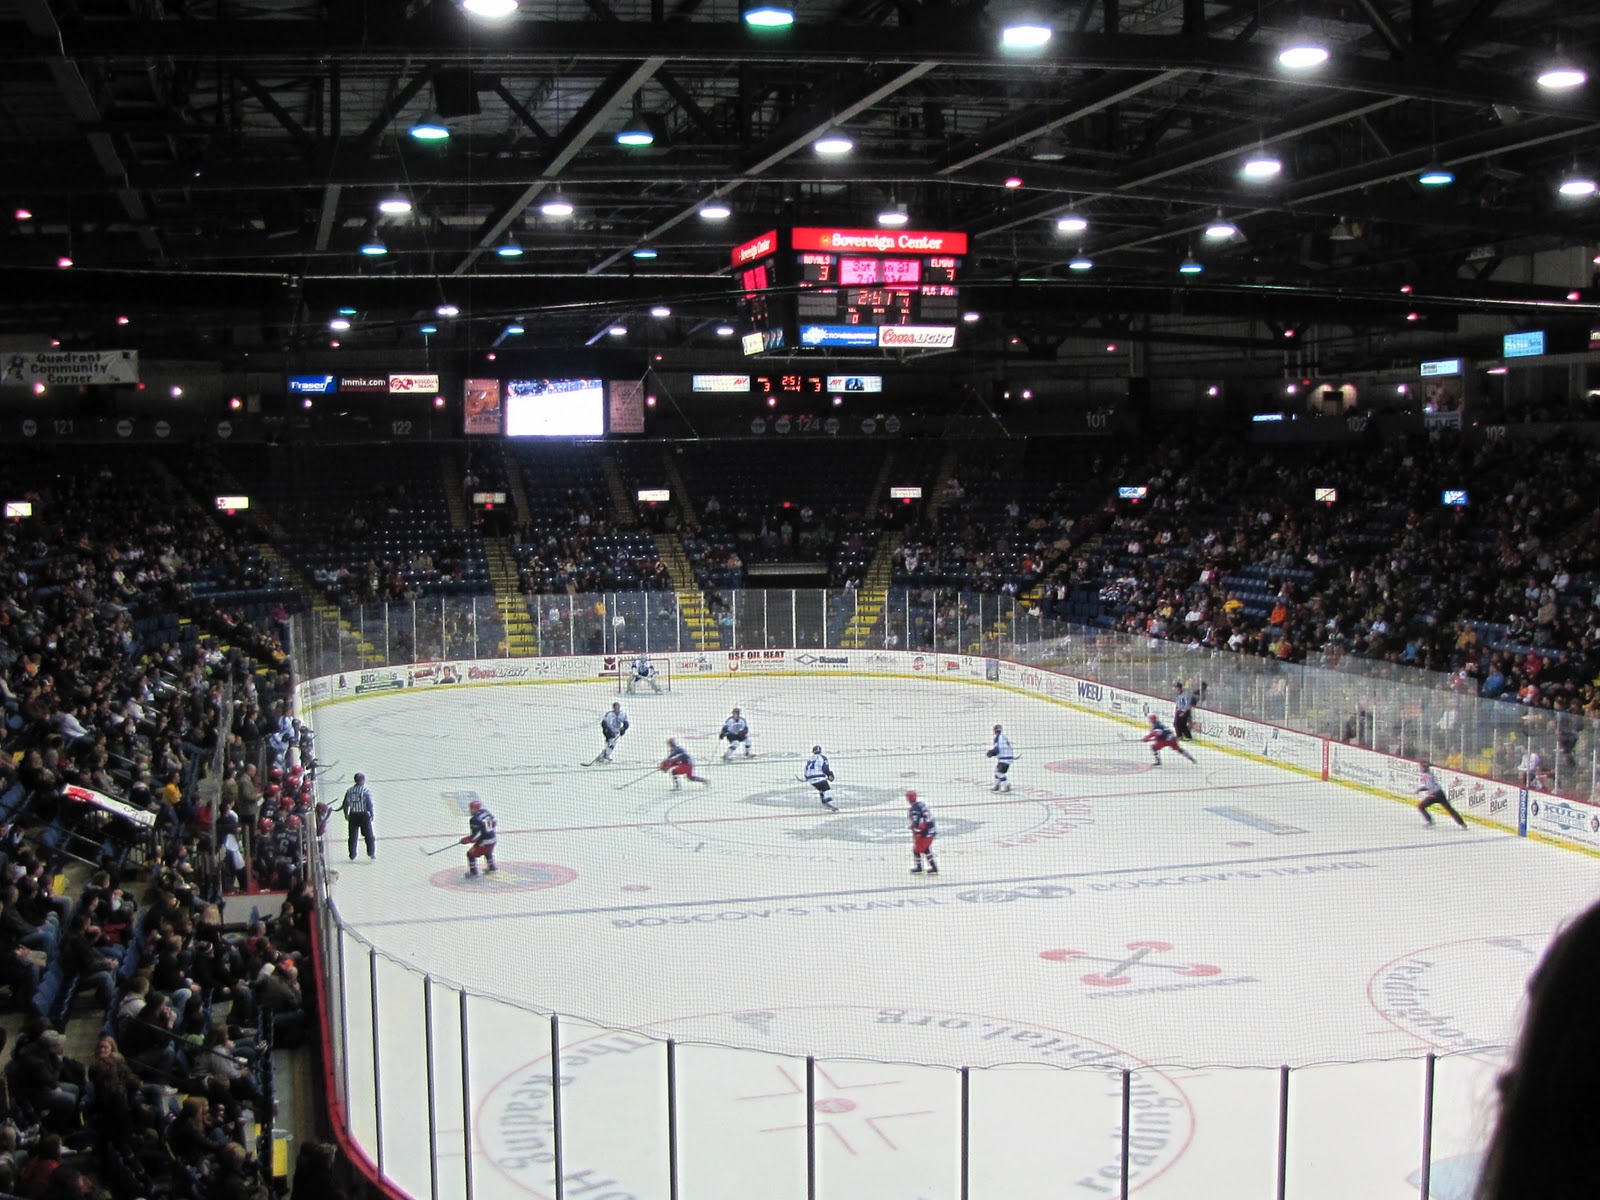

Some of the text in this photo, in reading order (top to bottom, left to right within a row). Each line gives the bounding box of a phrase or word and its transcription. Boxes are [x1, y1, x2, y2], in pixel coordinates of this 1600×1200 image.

[832, 233, 943, 251] Sovereign Center
[803, 255, 831, 265] ROYALS
[818, 266, 830, 281] 3
[882, 329, 953, 344] Coors LIGHT
[36, 353, 101, 363] Quadrant
[31, 362, 108, 374] Community
[47, 374, 93, 384] Corner
[341, 378, 386, 387] immix.com
[782, 375, 802, 385] 2:51
[764, 382, 770, 392] 3
[815, 383, 821, 392] 3
[53, 419, 74, 435] 121
[392, 420, 412, 435] 122
[796, 418, 821, 431] 124
[1086, 413, 1107, 428] 101
[728, 650, 785, 660] USE OIL HEAT
[819, 656, 848, 664] Diamond
[467, 666, 529, 679] Coors LIGHT
[1077, 681, 1103, 702] WEEU
[1228, 724, 1246, 739] BODY
[1448, 787, 1465, 801] Blue
[1469, 793, 1485, 807] Blue
[1490, 798, 1508, 813] Blue
[1520, 789, 1528, 824] Reebok
[1544, 804, 1586, 821] KULP
[1088, 860, 1380, 892] BOSCOV'S TRAVEL
[612, 896, 950, 929] BOSCOV'S TRAVEL
